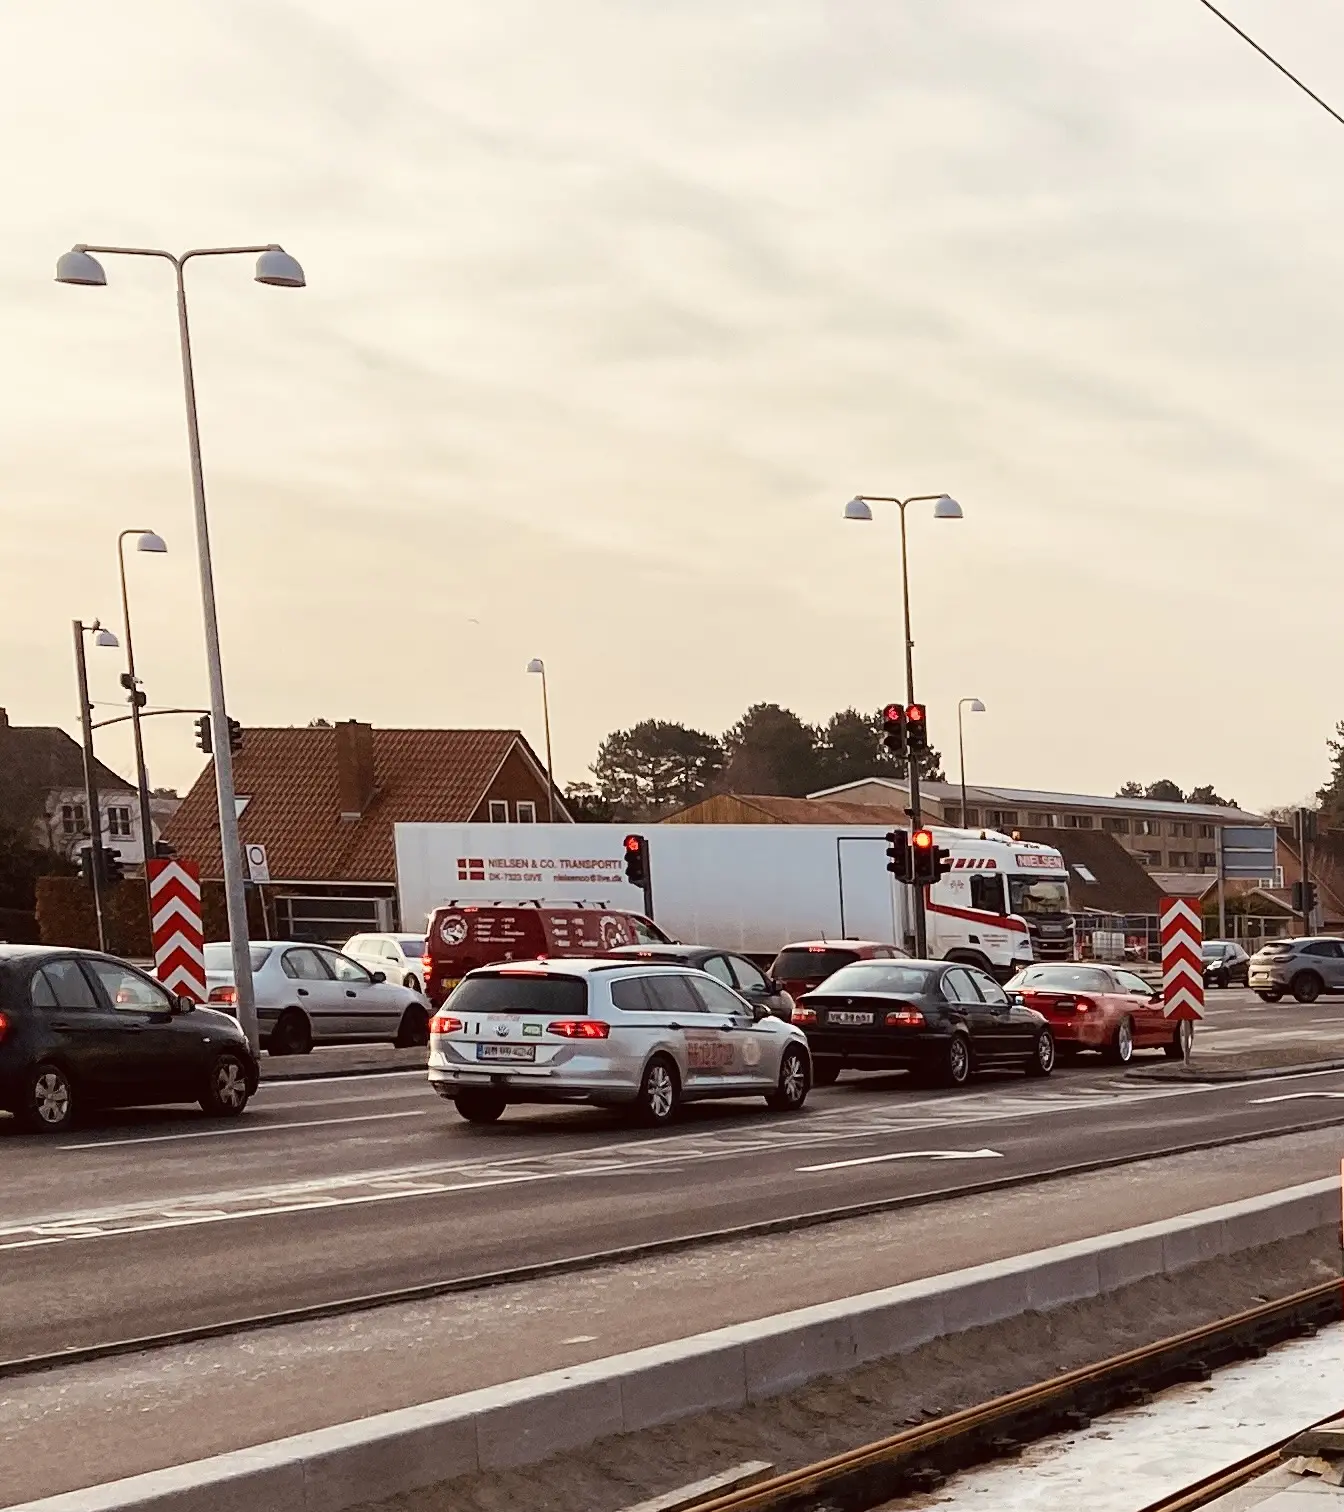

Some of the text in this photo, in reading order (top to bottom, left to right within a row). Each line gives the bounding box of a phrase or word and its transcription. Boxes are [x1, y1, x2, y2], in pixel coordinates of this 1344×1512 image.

[488, 858, 529, 869] NIELSEN
[531, 859, 538, 869] &
[1017, 855, 1062, 868] NIELSEN
